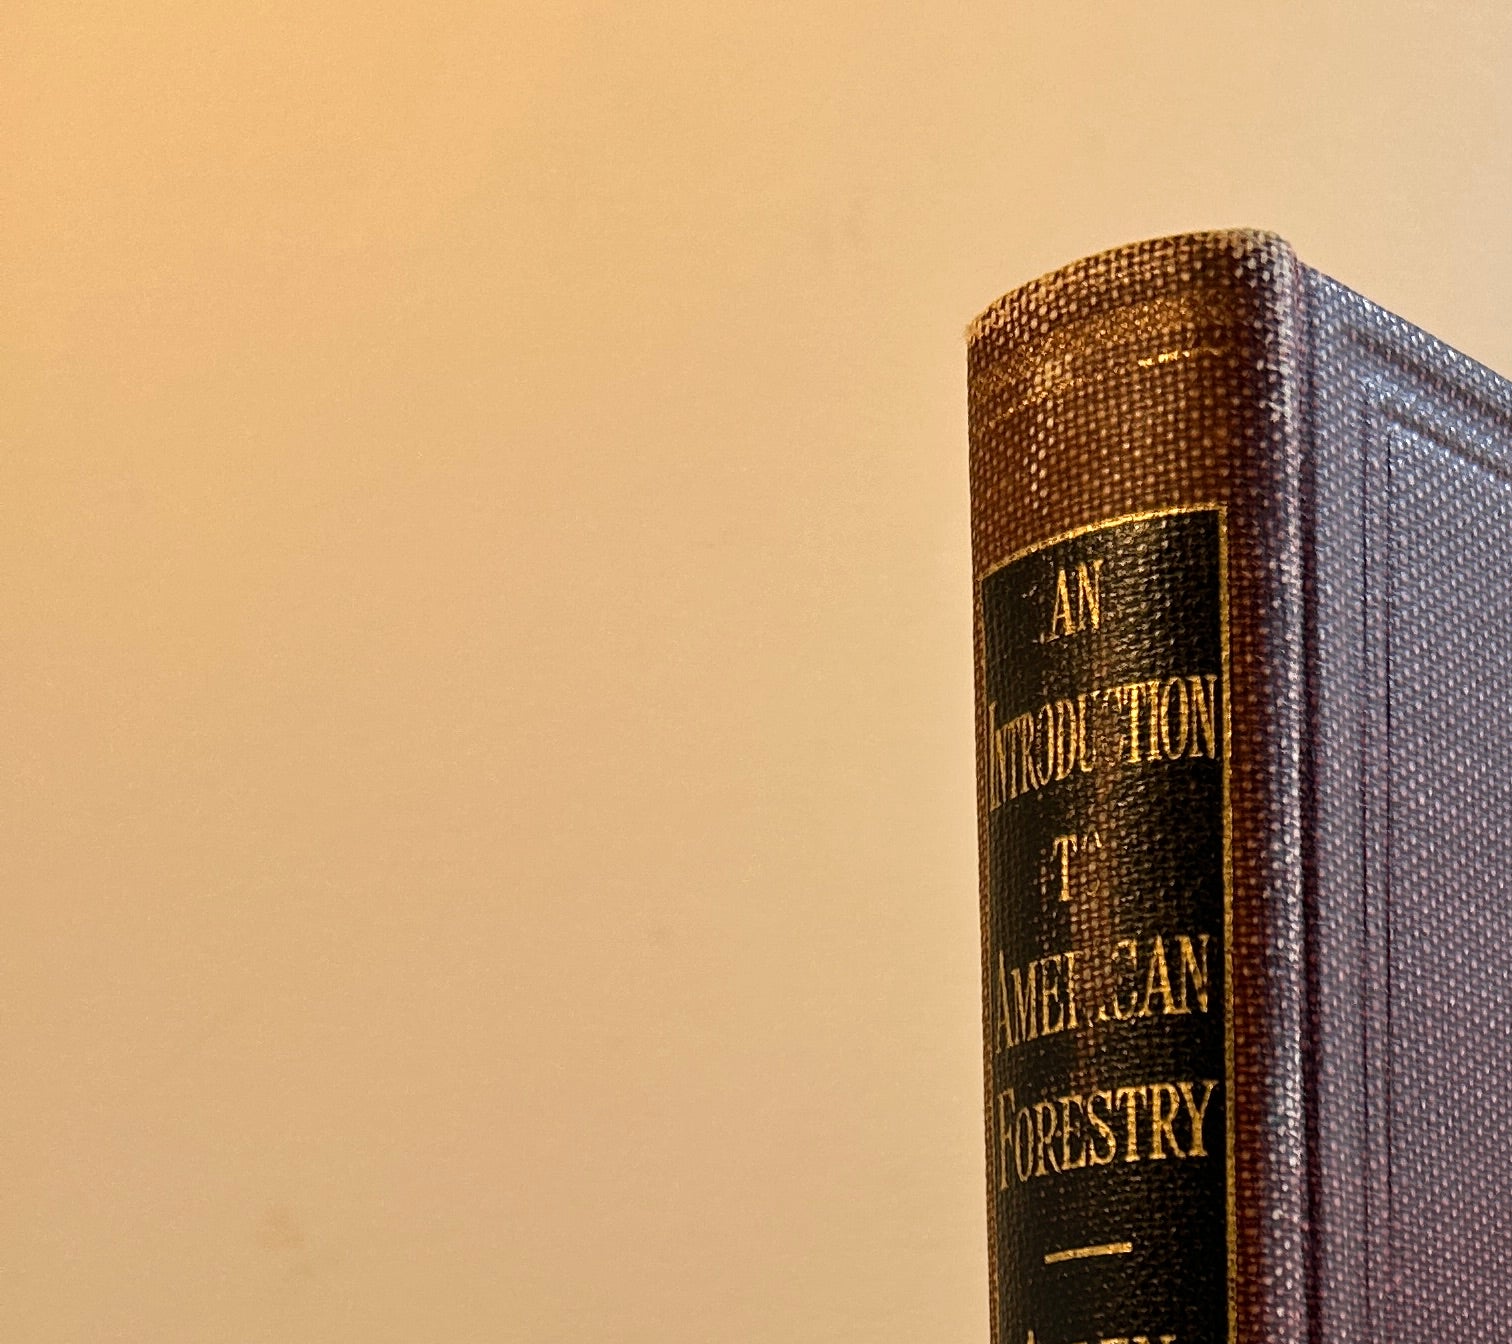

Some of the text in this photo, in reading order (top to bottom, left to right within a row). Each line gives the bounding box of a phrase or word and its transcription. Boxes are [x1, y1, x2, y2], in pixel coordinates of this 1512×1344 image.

[1046, 560, 1102, 641] AN
[996, 934, 1210, 1053] AMECAN
[1000, 1080, 1217, 1191] FORESTRY
